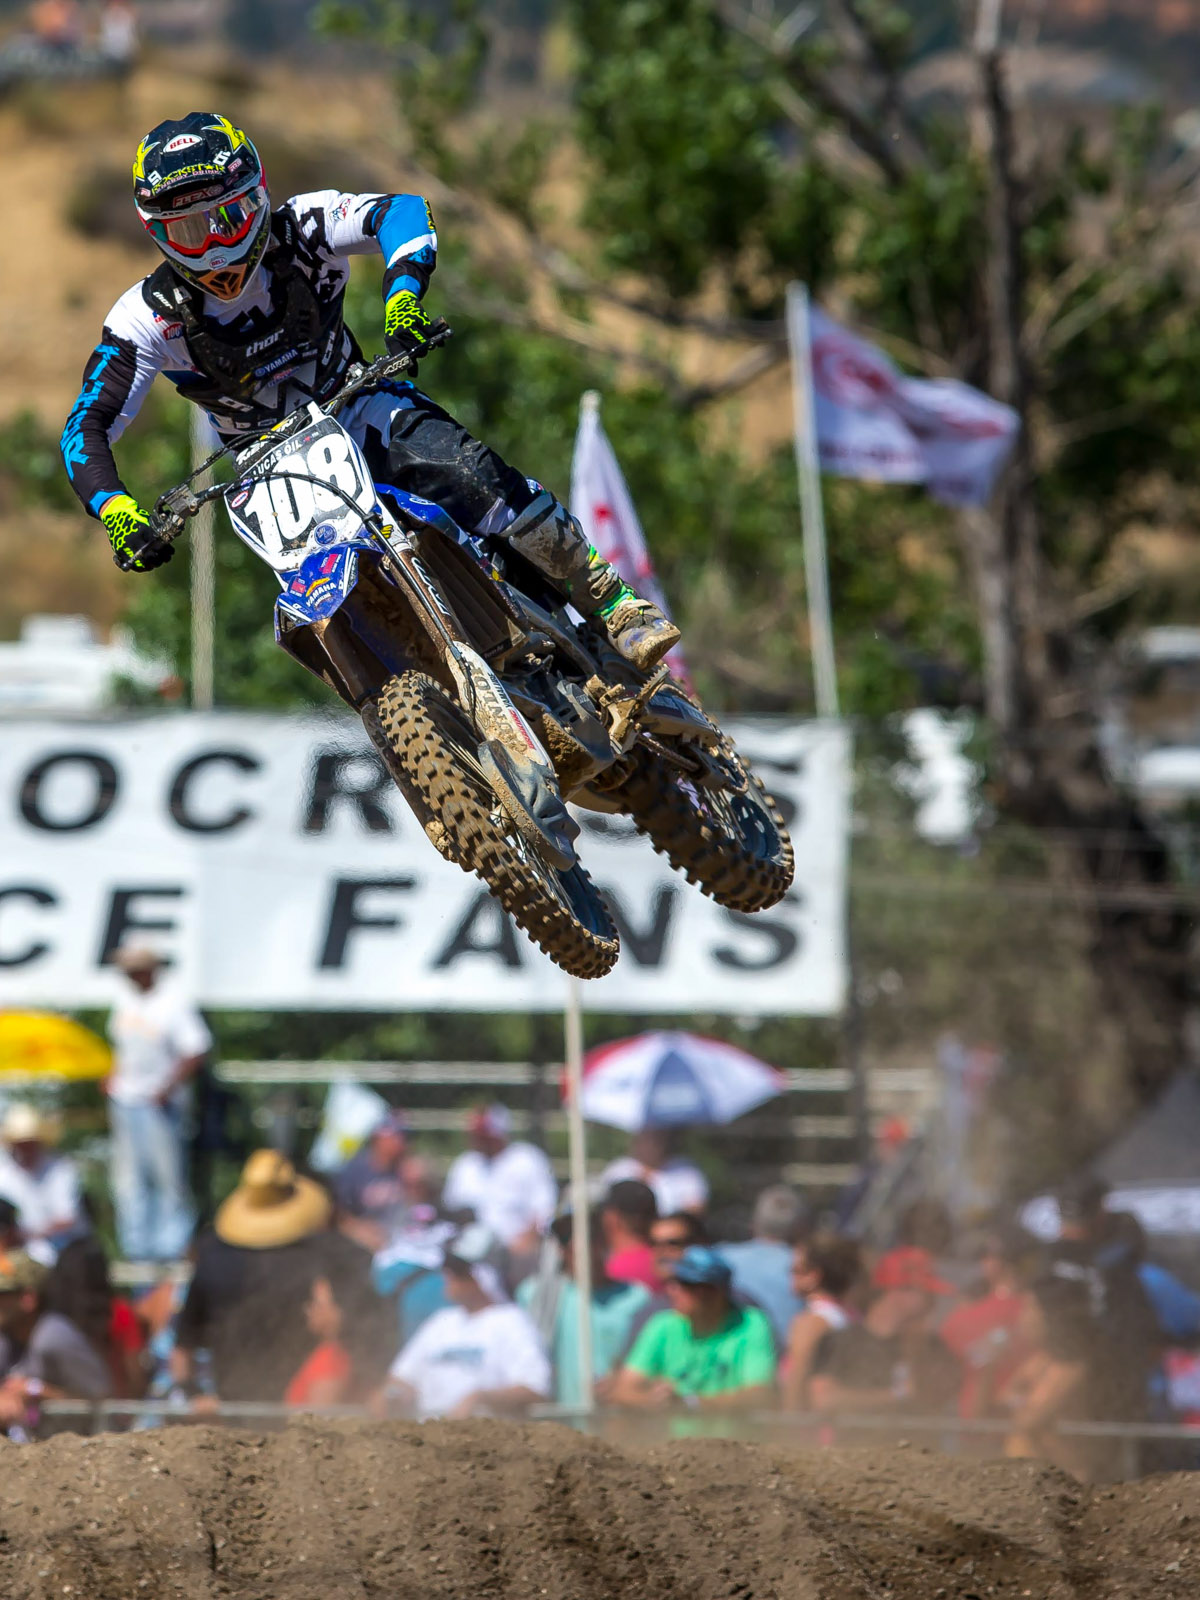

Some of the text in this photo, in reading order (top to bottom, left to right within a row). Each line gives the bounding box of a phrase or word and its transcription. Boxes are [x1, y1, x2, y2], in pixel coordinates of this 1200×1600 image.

[169, 137, 196, 150] BELL
[245, 328, 285, 358] thor
[264, 348, 299, 372] YAMAHA
[252, 439, 303, 481] LUCAS OIL
[244, 433, 357, 549] 108
[305, 582, 337, 607] YAMAHA
[316, 876, 799, 971] FANS
